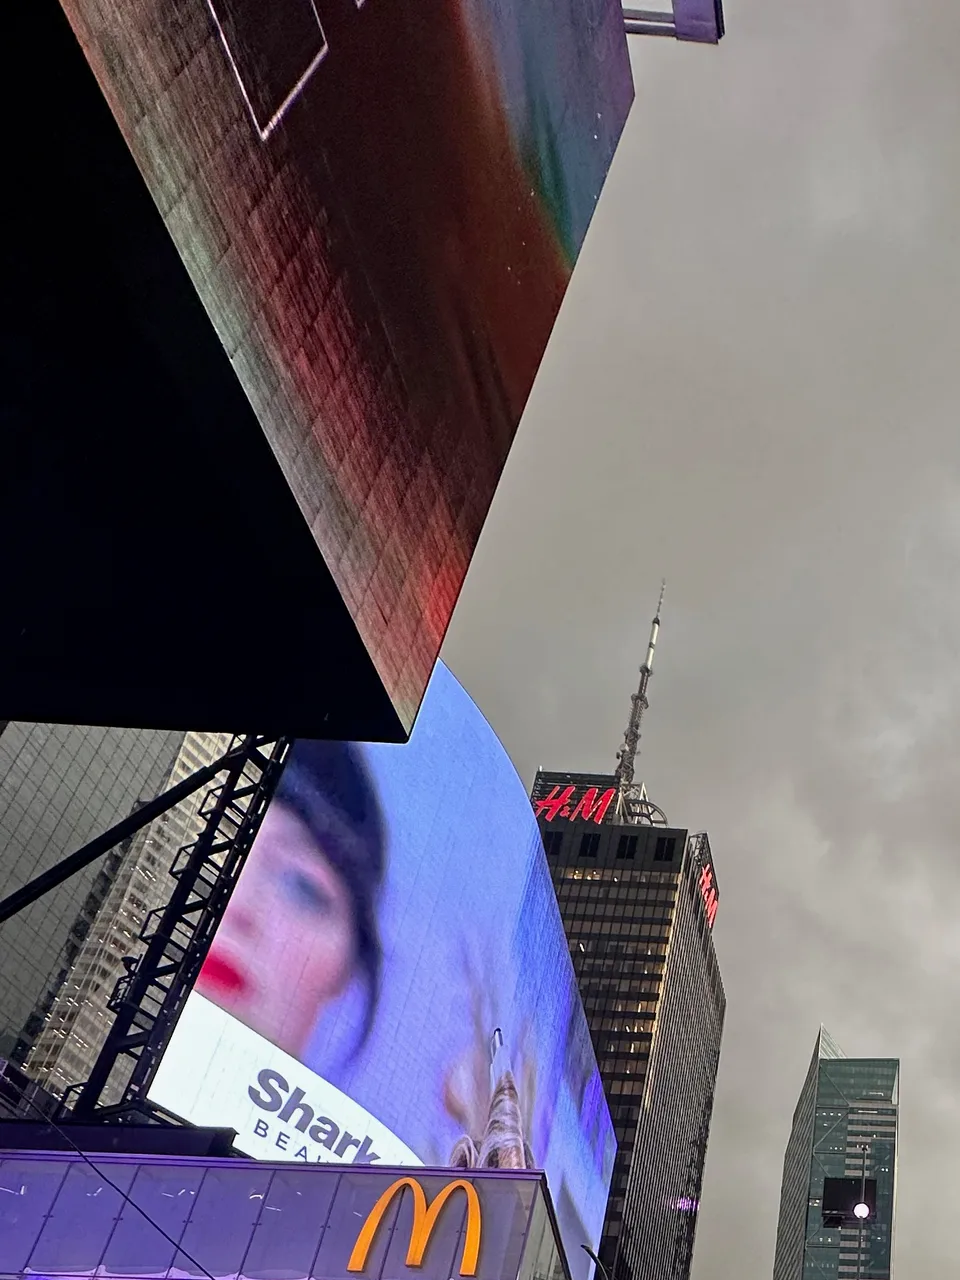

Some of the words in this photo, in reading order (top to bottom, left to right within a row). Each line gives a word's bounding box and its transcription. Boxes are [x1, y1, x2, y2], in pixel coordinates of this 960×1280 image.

[535, 785, 616, 824] H&M
[248, 1068, 381, 1164] Shark
[253, 1118, 330, 1163] BEA
